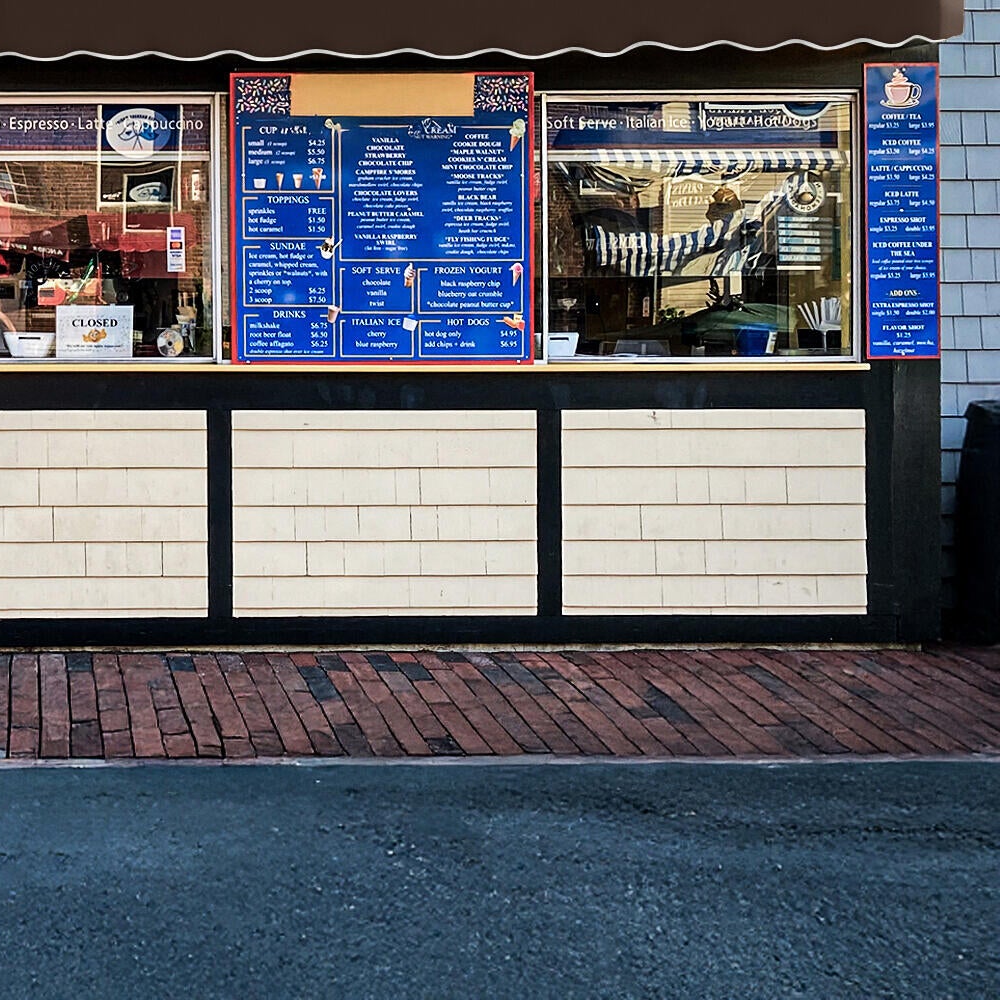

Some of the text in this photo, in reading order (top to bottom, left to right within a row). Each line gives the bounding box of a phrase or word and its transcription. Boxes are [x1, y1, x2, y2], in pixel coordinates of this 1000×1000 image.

[9, 117, 69, 133] Espresso
[78, 117, 113, 130] Latte
[124, 116, 204, 133] Cappuccino
[547, 115, 575, 129] Soft
[579, 116, 617, 130] Serve
[626, 115, 666, 129] Italian
[669, 116, 688, 129] Ice
[259, 126, 278, 134] CUP
[308, 139, 326, 147] $4.25
[248, 158, 263, 166] large
[268, 196, 310, 204] TOPPINGS
[270, 242, 306, 250] SUNDAE
[487, 280, 501, 288] chip
[71, 318, 118, 328] CLOSED
[436, 330, 447, 339] dog
[448, 331, 461, 339] only
[370, 341, 398, 349] raspberry
[437, 341, 453, 349] chips
